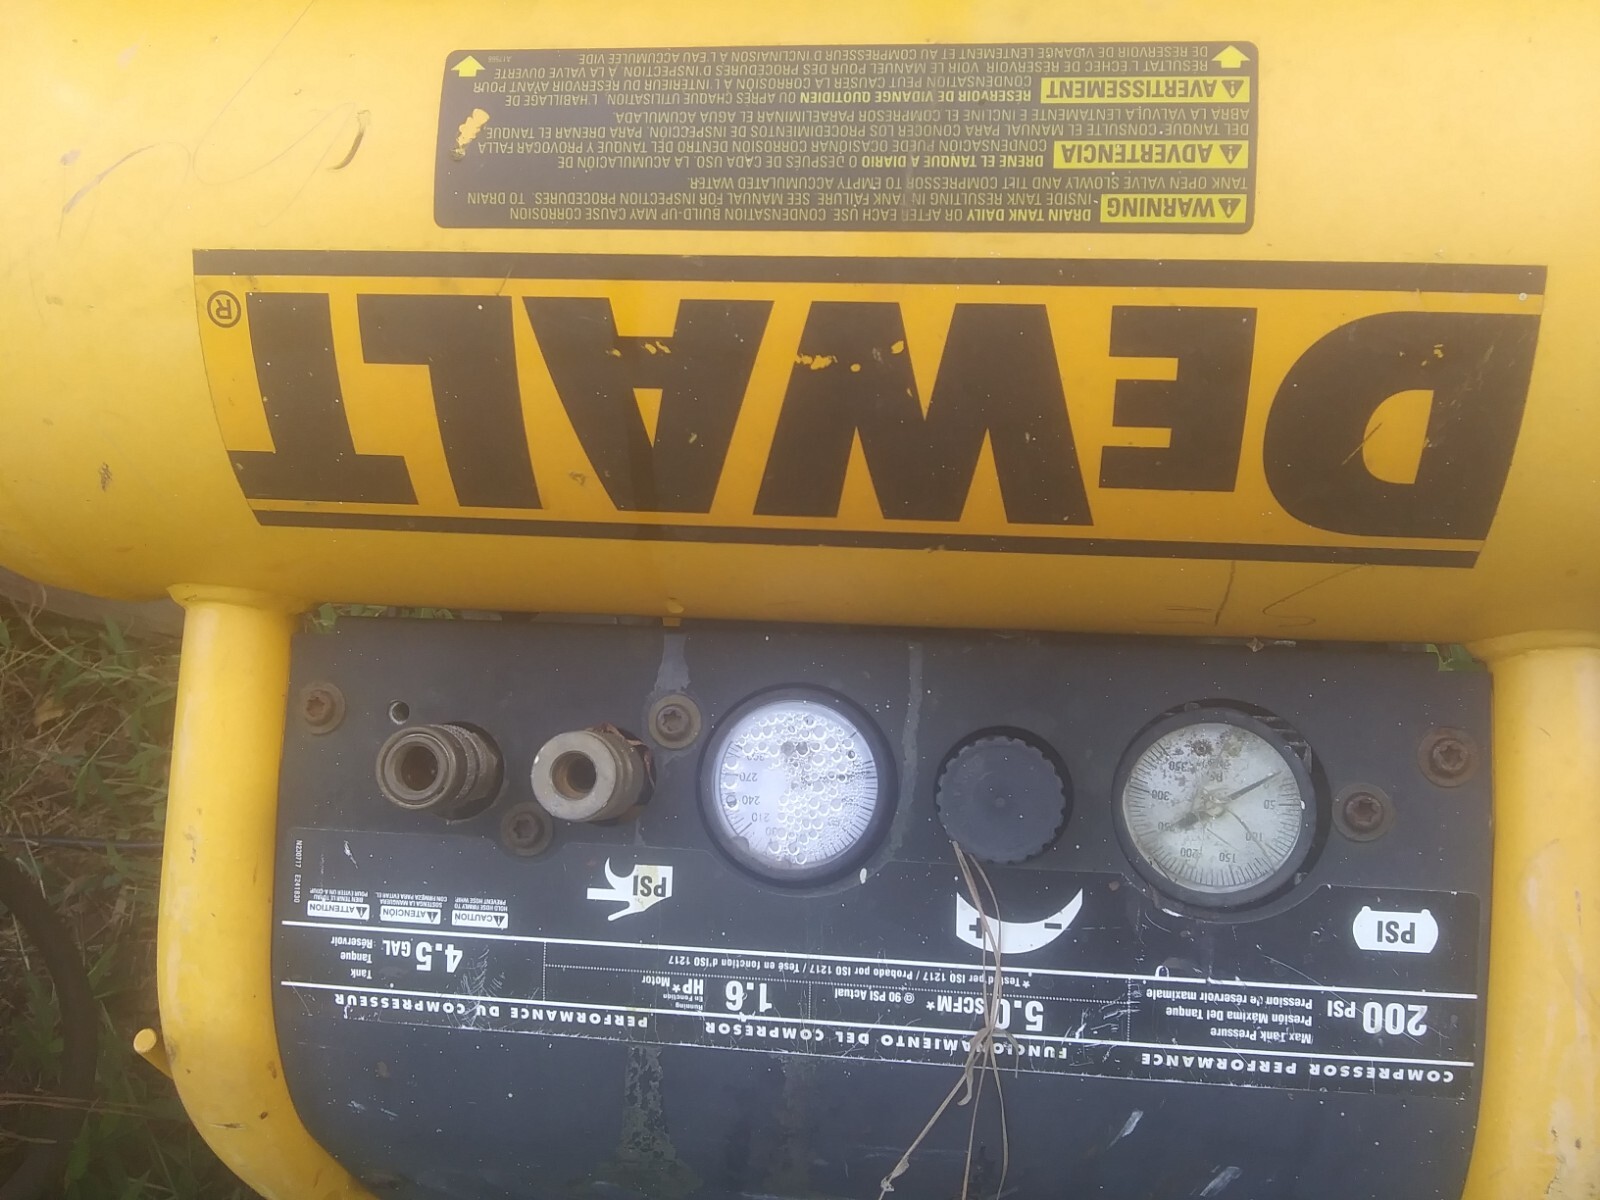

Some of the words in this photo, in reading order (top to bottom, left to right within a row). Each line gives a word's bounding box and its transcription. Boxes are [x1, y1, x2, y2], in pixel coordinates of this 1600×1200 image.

[826, 48, 917, 61] COMPRESSEUR
[959, 47, 1034, 60] LENTEMENT
[494, 66, 546, 80] OUVERTE
[549, 65, 586, 79] VALVE
[803, 62, 828, 75] DES
[832, 62, 867, 75] POUR
[870, 61, 927, 75] MANUEL
[949, 61, 979, 74] VOIR
[473, 80, 507, 94] POUR
[508, 79, 550, 93] AYANT
[737, 77, 811, 90] CORROSION
[835, 76, 886, 89] CAUSER
[889, 76, 923, 89] PEUT
[927, 75, 1032, 88] CONDENSATION
[1046, 79, 1217, 99] AVERTISSEMENT
[524, 94, 598, 107] L'HABILLAGE
[684, 92, 733, 105] CHAQUE
[800, 91, 871, 104] QUOTIDIEN
[875, 90, 934, 104] VIDANGE
[700, 110, 737, 123] AGUA
[859, 109, 941, 122] COMPRESOR
[964, 108, 1016, 121] INCLINE
[1032, 107, 1121, 121] LENTAMENTE
[1211, 106, 1250, 119] ABRA
[556, 126, 606, 139] DRENAR
[610, 125, 643, 139] PARA
[751, 124, 866, 137] PROCEDIMIENTOS
[870, 124, 894, 136] LOS
[898, 123, 961, 136] CONOCER
[965, 123, 1000, 136] PARA
[1005, 123, 1064, 136] MANUAL
[1088, 122, 1157, 135] CONSULTE
[1224, 122, 1249, 136] DEL
[478, 141, 514, 153] FALLA
[517, 141, 584, 153] PROVOCAR
[598, 141, 647, 153] TANQUE
[651, 140, 674, 153] DEL
[678, 140, 729, 153] DENTRO
[812, 140, 888, 152] OCASIONAR
[893, 139, 935, 152] PUEDE
[1061, 144, 1213, 163] ADVERTENCIA
[727, 155, 762, 168] CADA
[862, 155, 907, 168] DIARIO
[911, 155, 920, 168] A
[924, 155, 976, 167] TANQUE
[980, 155, 996, 167] EL
[1000, 155, 1044, 167] DRENE
[738, 176, 835, 189] ACCUMULATED
[838, 176, 882, 189] EMPTY
[906, 176, 998, 189] COMPRESSOR
[1004, 176, 1027, 189] TILT
[1033, 176, 1062, 189] AND
[1066, 176, 1120, 189] SLOWLY
[1124, 176, 1166, 189] VALVE
[1170, 176, 1207, 189] OPEN
[1212, 176, 1247, 190] TANK
[468, 191, 506, 205] DRAIN
[620, 192, 696, 205] INSPECTION
[700, 192, 723, 205] FOR
[727, 192, 784, 205] MANUAL
[788, 193, 811, 205] SEE
[931, 192, 1003, 205] RESULTING
[1007, 192, 1041, 205] TANK
[1047, 192, 1092, 205] INSIDE
[510, 207, 582, 220] CORROSION
[586, 207, 627, 220] CAUSE
[630, 207, 658, 221] MAY
[661, 207, 721, 221] BUILD-UP
[1108, 197, 1215, 218] WARNING
[725, 208, 827, 221] CONDENSATION
[863, 208, 897, 221] EACH
[945, 208, 963, 221] OR
[967, 208, 1005, 221] DAILY
[1009, 208, 1045, 221] TANK
[1049, 208, 1091, 221] DRAIN
[228, 291, 1540, 540] DEWALT
[1168, 762, 1187, 771] 350
[739, 772, 757, 781] 270
[742, 795, 760, 804] 240
[1152, 790, 1170, 800] 300
[1264, 800, 1276, 809] 50
[752, 813, 769, 822] 210
[1180, 848, 1198, 858] 200
[1219, 853, 1236, 862] 150
[293, 873, 301, 903] E241830
[633, 875, 666, 897] PSI
[310, 904, 355, 913] ATTENTION
[383, 909, 426, 917] ATENCIÓN
[455, 913, 492, 922] CAUTION
[1377, 921, 1415, 944] PSI
[331, 936, 373, 949] Réservoir
[383, 940, 411, 957] GAL
[340, 951, 372, 963] Tanque
[416, 941, 463, 973] 4.5
[669, 955, 690, 965] 1217
[694, 956, 718, 967] d'ISO
[721, 958, 760, 970] fonction
[764, 961, 775, 970] en
[779, 962, 799, 974] Tesé
[810, 963, 832, 975] 1217
[351, 968, 372, 979] Tank
[835, 966, 851, 977] ISO
[855, 965, 870, 977] por
[873, 968, 913, 980] Probado
[923, 971, 946, 982] 1217
[641, 975, 670, 987] Motor
[950, 973, 965, 984] ISO
[969, 972, 983, 984] per
[725, 980, 772, 1012] 1.6
[835, 988, 867, 1000] Actual
[869, 989, 886, 1002] PSI
[889, 991, 902, 1003] 90
[1146, 989, 1196, 1001] maximale
[1200, 992, 1247, 1005] réservoir
[334, 994, 465, 1014] COMPRESSEUR
[675, 1001, 703, 1010] Running
[1267, 997, 1312, 1009] Pression
[1327, 1000, 1355, 1018] PSI
[475, 1004, 500, 1017] DU
[1166, 1005, 1203, 1019] Tanque
[1207, 1010, 1223, 1021] Del
[510, 1007, 648, 1028] PERFORMANCE
[1227, 1011, 1268, 1024] Máxima
[1272, 1014, 1312, 1026] Presión
[1363, 1002, 1427, 1035] 200
[705, 1022, 824, 1042] COMPRESOR
[835, 1031, 869, 1044] DEL
[1210, 1028, 1256, 1040] Pressure
[881, 1034, 1067, 1059] FUNCIOAMIENTO
[1141, 1053, 1296, 1075] PERFORMANCE
[1309, 1064, 1454, 1083] COMPRESSOR
